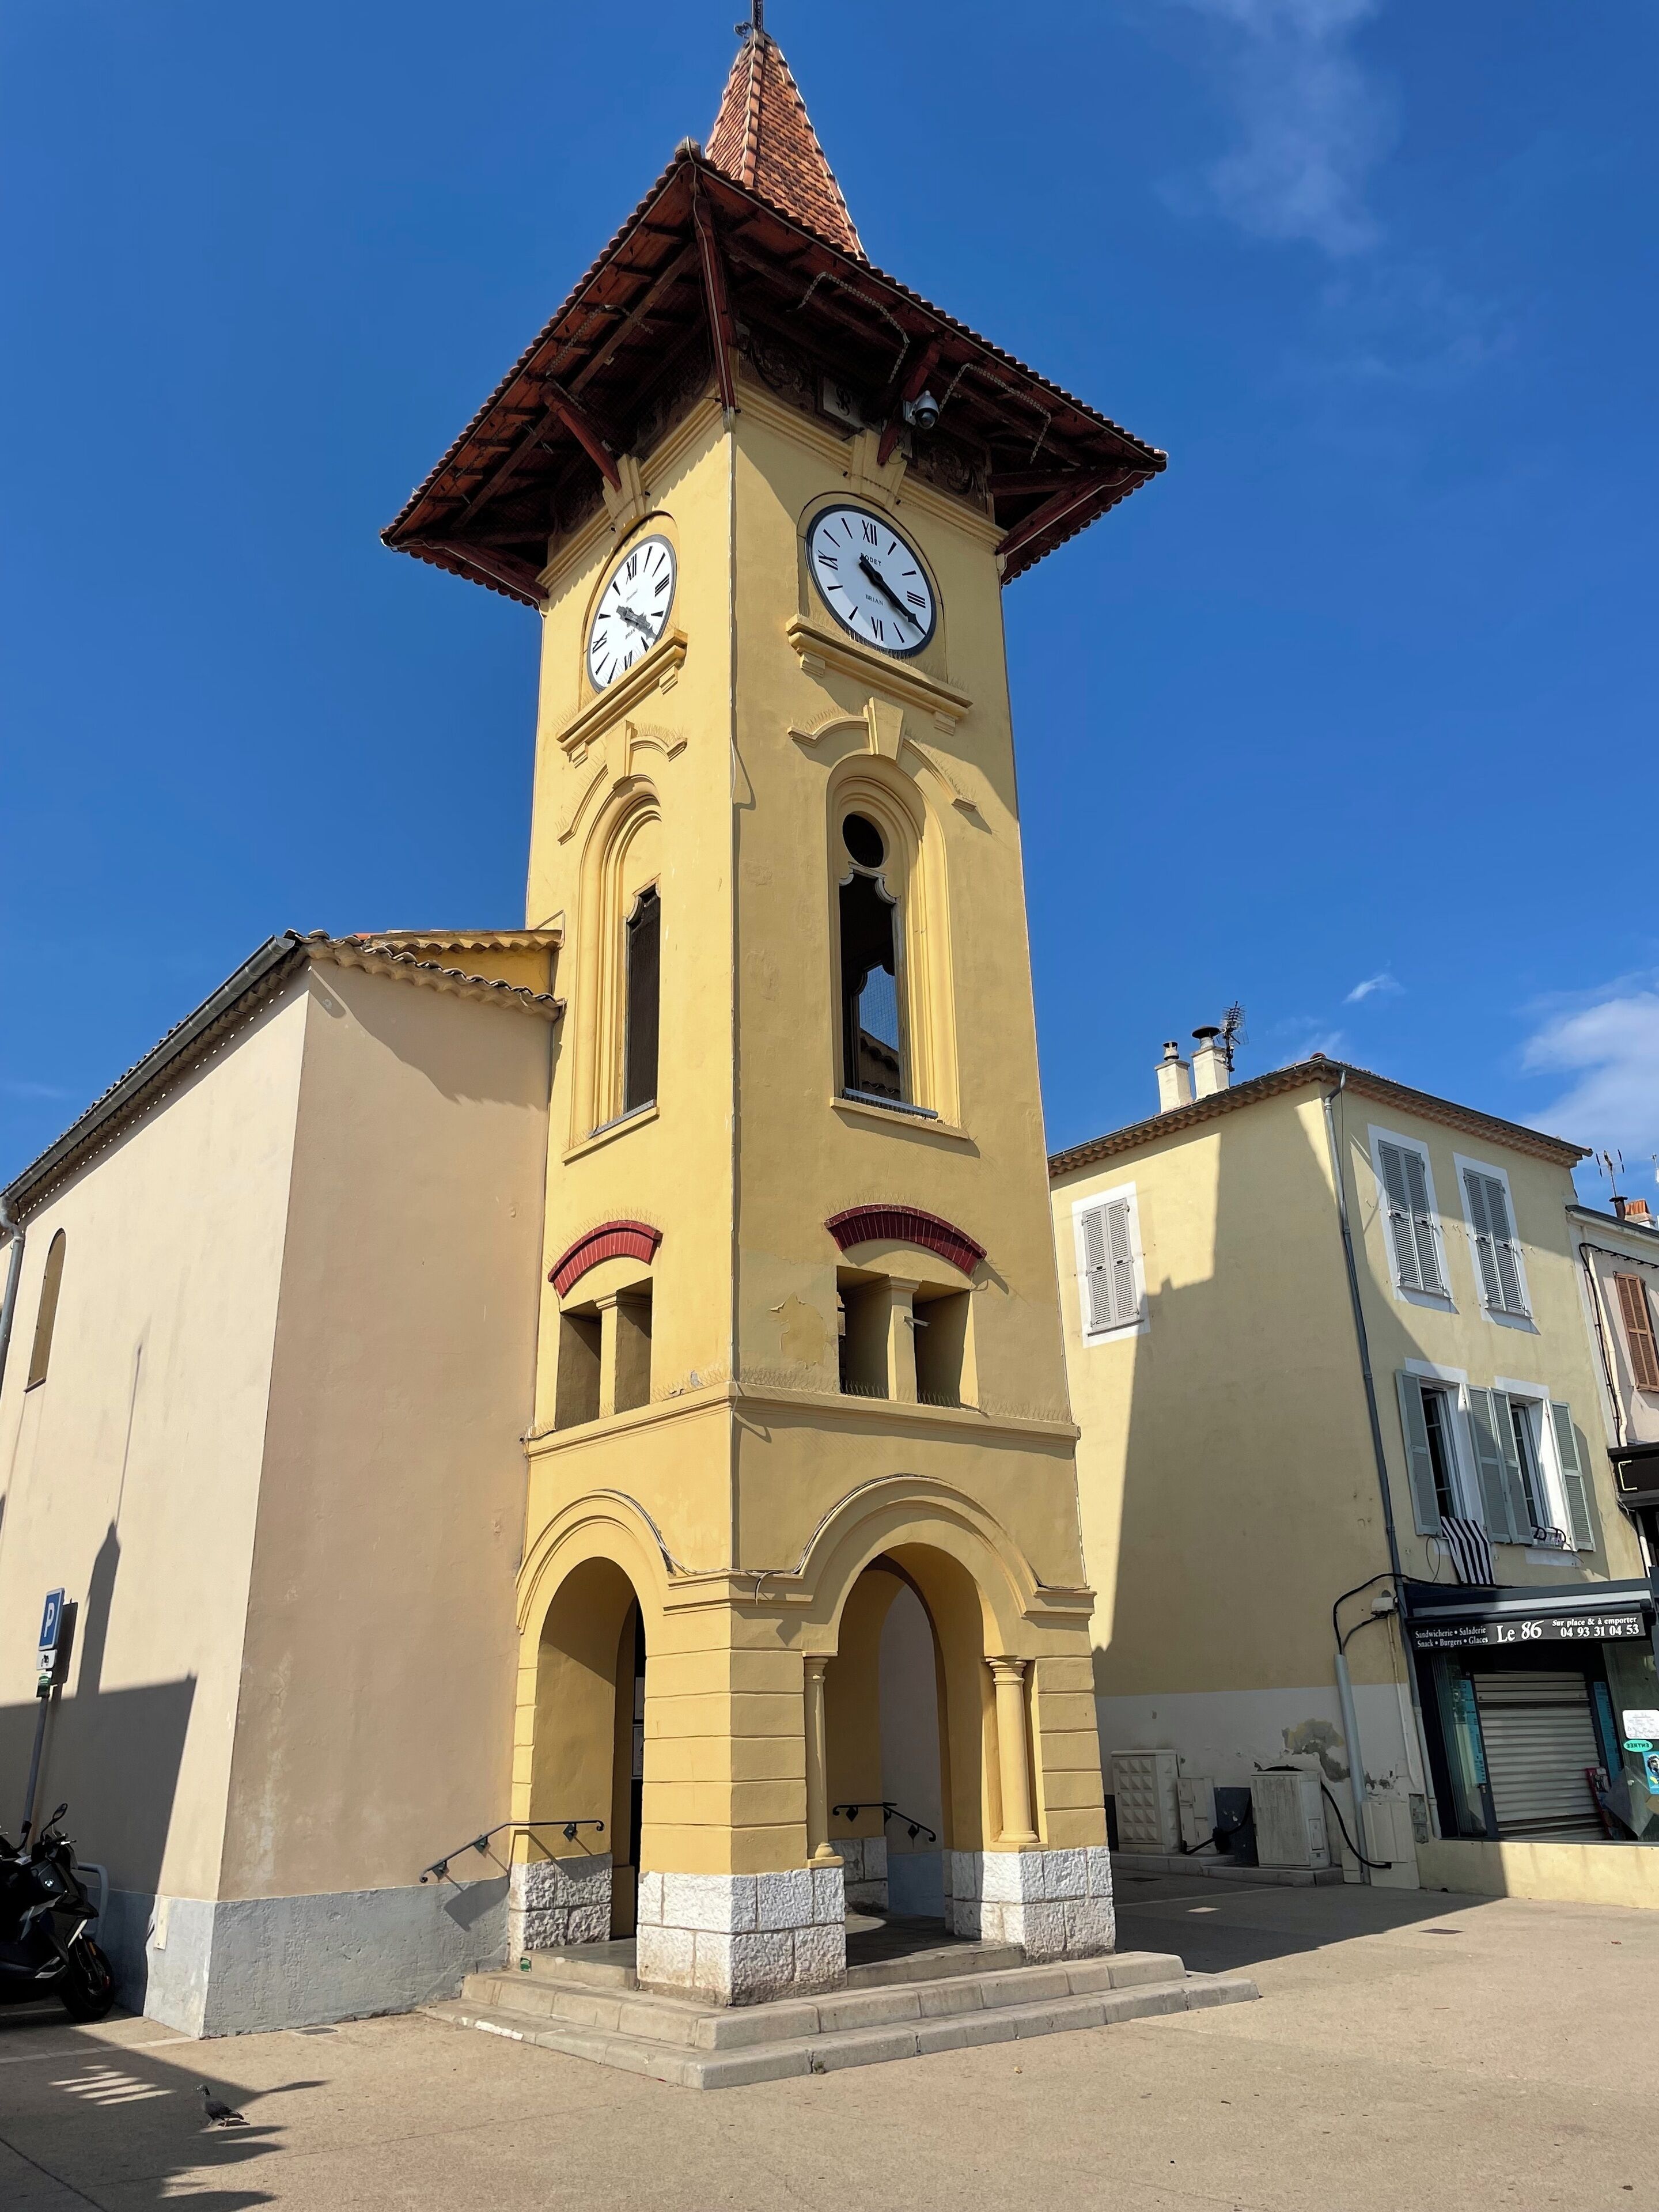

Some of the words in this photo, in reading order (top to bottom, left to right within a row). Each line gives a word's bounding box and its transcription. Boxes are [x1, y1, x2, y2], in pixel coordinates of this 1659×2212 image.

[861, 519, 877, 546] XII
[626, 553, 638, 585] XII
[654, 573, 670, 597] III
[865, 594, 883, 605] BRIAN
[907, 590, 926, 608] III
[871, 616, 884, 642] VI
[44, 1602, 55, 1638] P
[1566, 1618, 1585, 1628] place
[1587, 1618, 1595, 1626] &
[1604, 1617, 1637, 1626] emporter
[1415, 1628, 1453, 1639] Sandwicherie
[1459, 1626, 1487, 1636] Saladerie
[1497, 1625, 1516, 1643] Le
[1521, 1620, 1544, 1640] 86
[1560, 1627, 1574, 1638] 04
[1577, 1626, 1590, 1637] 93
[1593, 1626, 1605, 1637] 31
[1609, 1625, 1623, 1636] 04
[1626, 1623, 1639, 1635] 53
[1417, 1639, 1434, 1648] Snack
[1440, 1638, 1463, 1648] Burgers
[1468, 1635, 1489, 1645] Glaces
